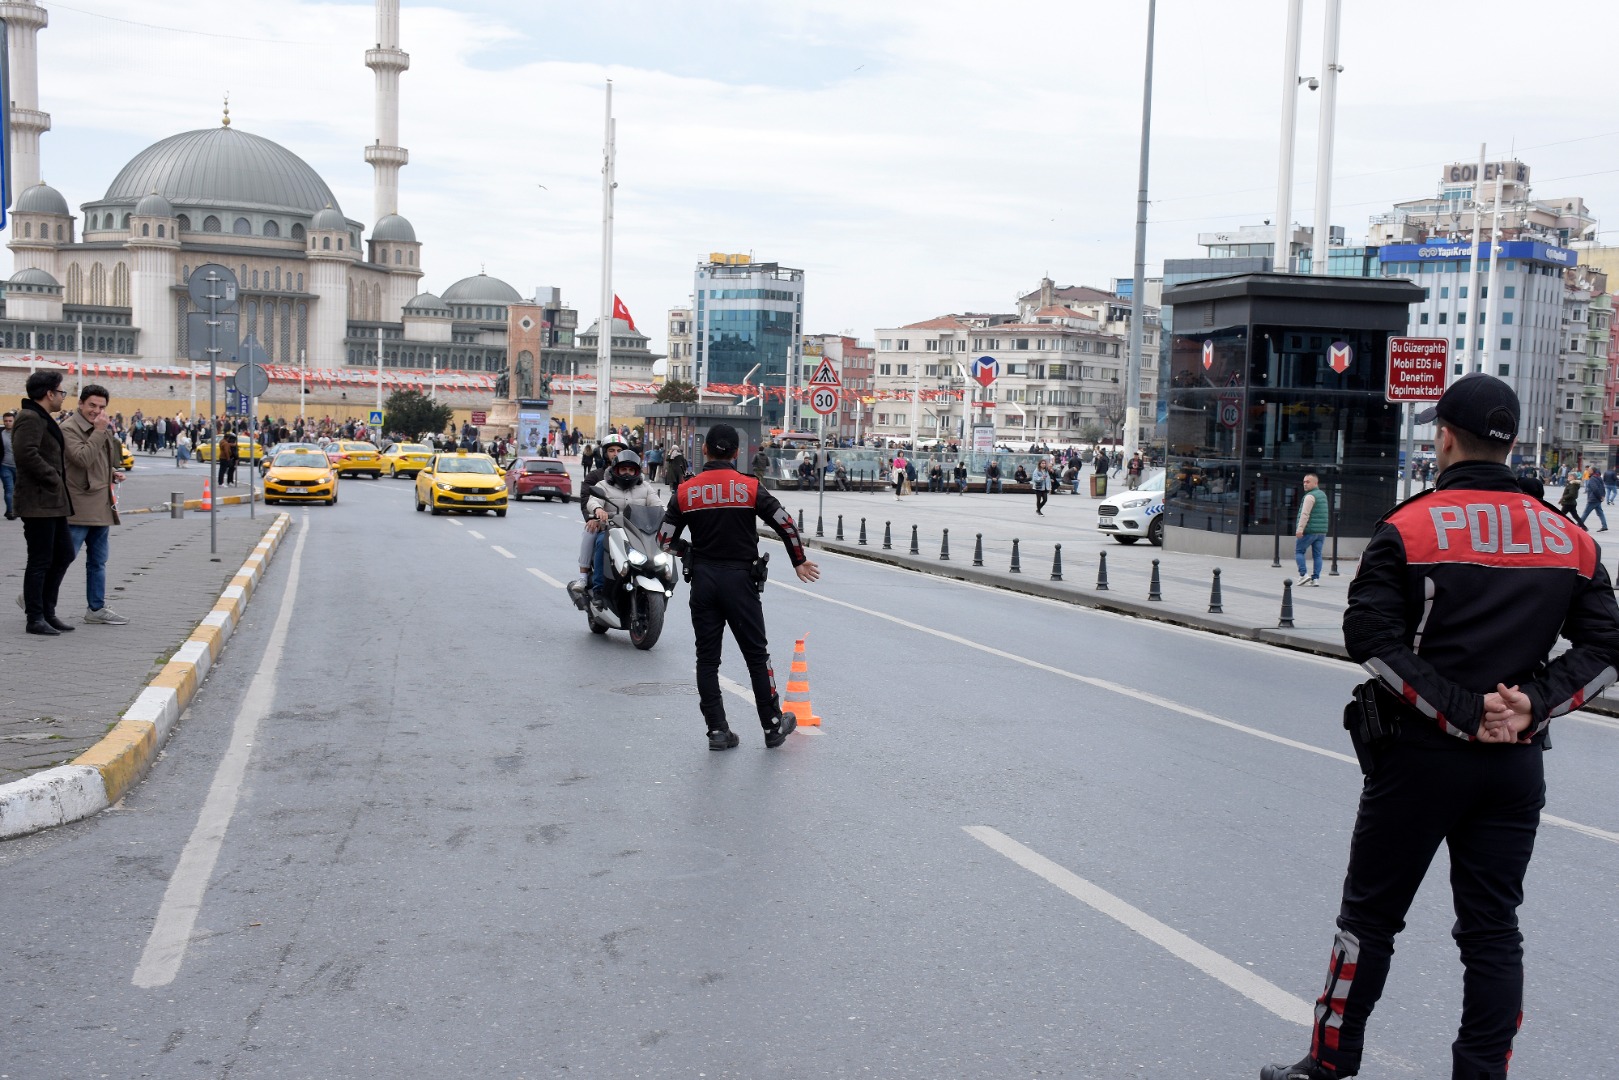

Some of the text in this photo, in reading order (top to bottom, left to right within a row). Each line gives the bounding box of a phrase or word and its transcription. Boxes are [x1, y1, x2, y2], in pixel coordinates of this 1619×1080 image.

[1437, 246, 1472, 257] YapıKred
[1392, 341, 1446, 356] Bu Güzergahta
[1393, 358, 1442, 369] Mobil EDS ile
[1400, 371, 1434, 382] Denetim
[1390, 384, 1443, 398] Yapılmaktadır
[816, 394, 833, 407] 30
[687, 480, 749, 507] POLİS
[1428, 500, 1573, 554] POLİS
